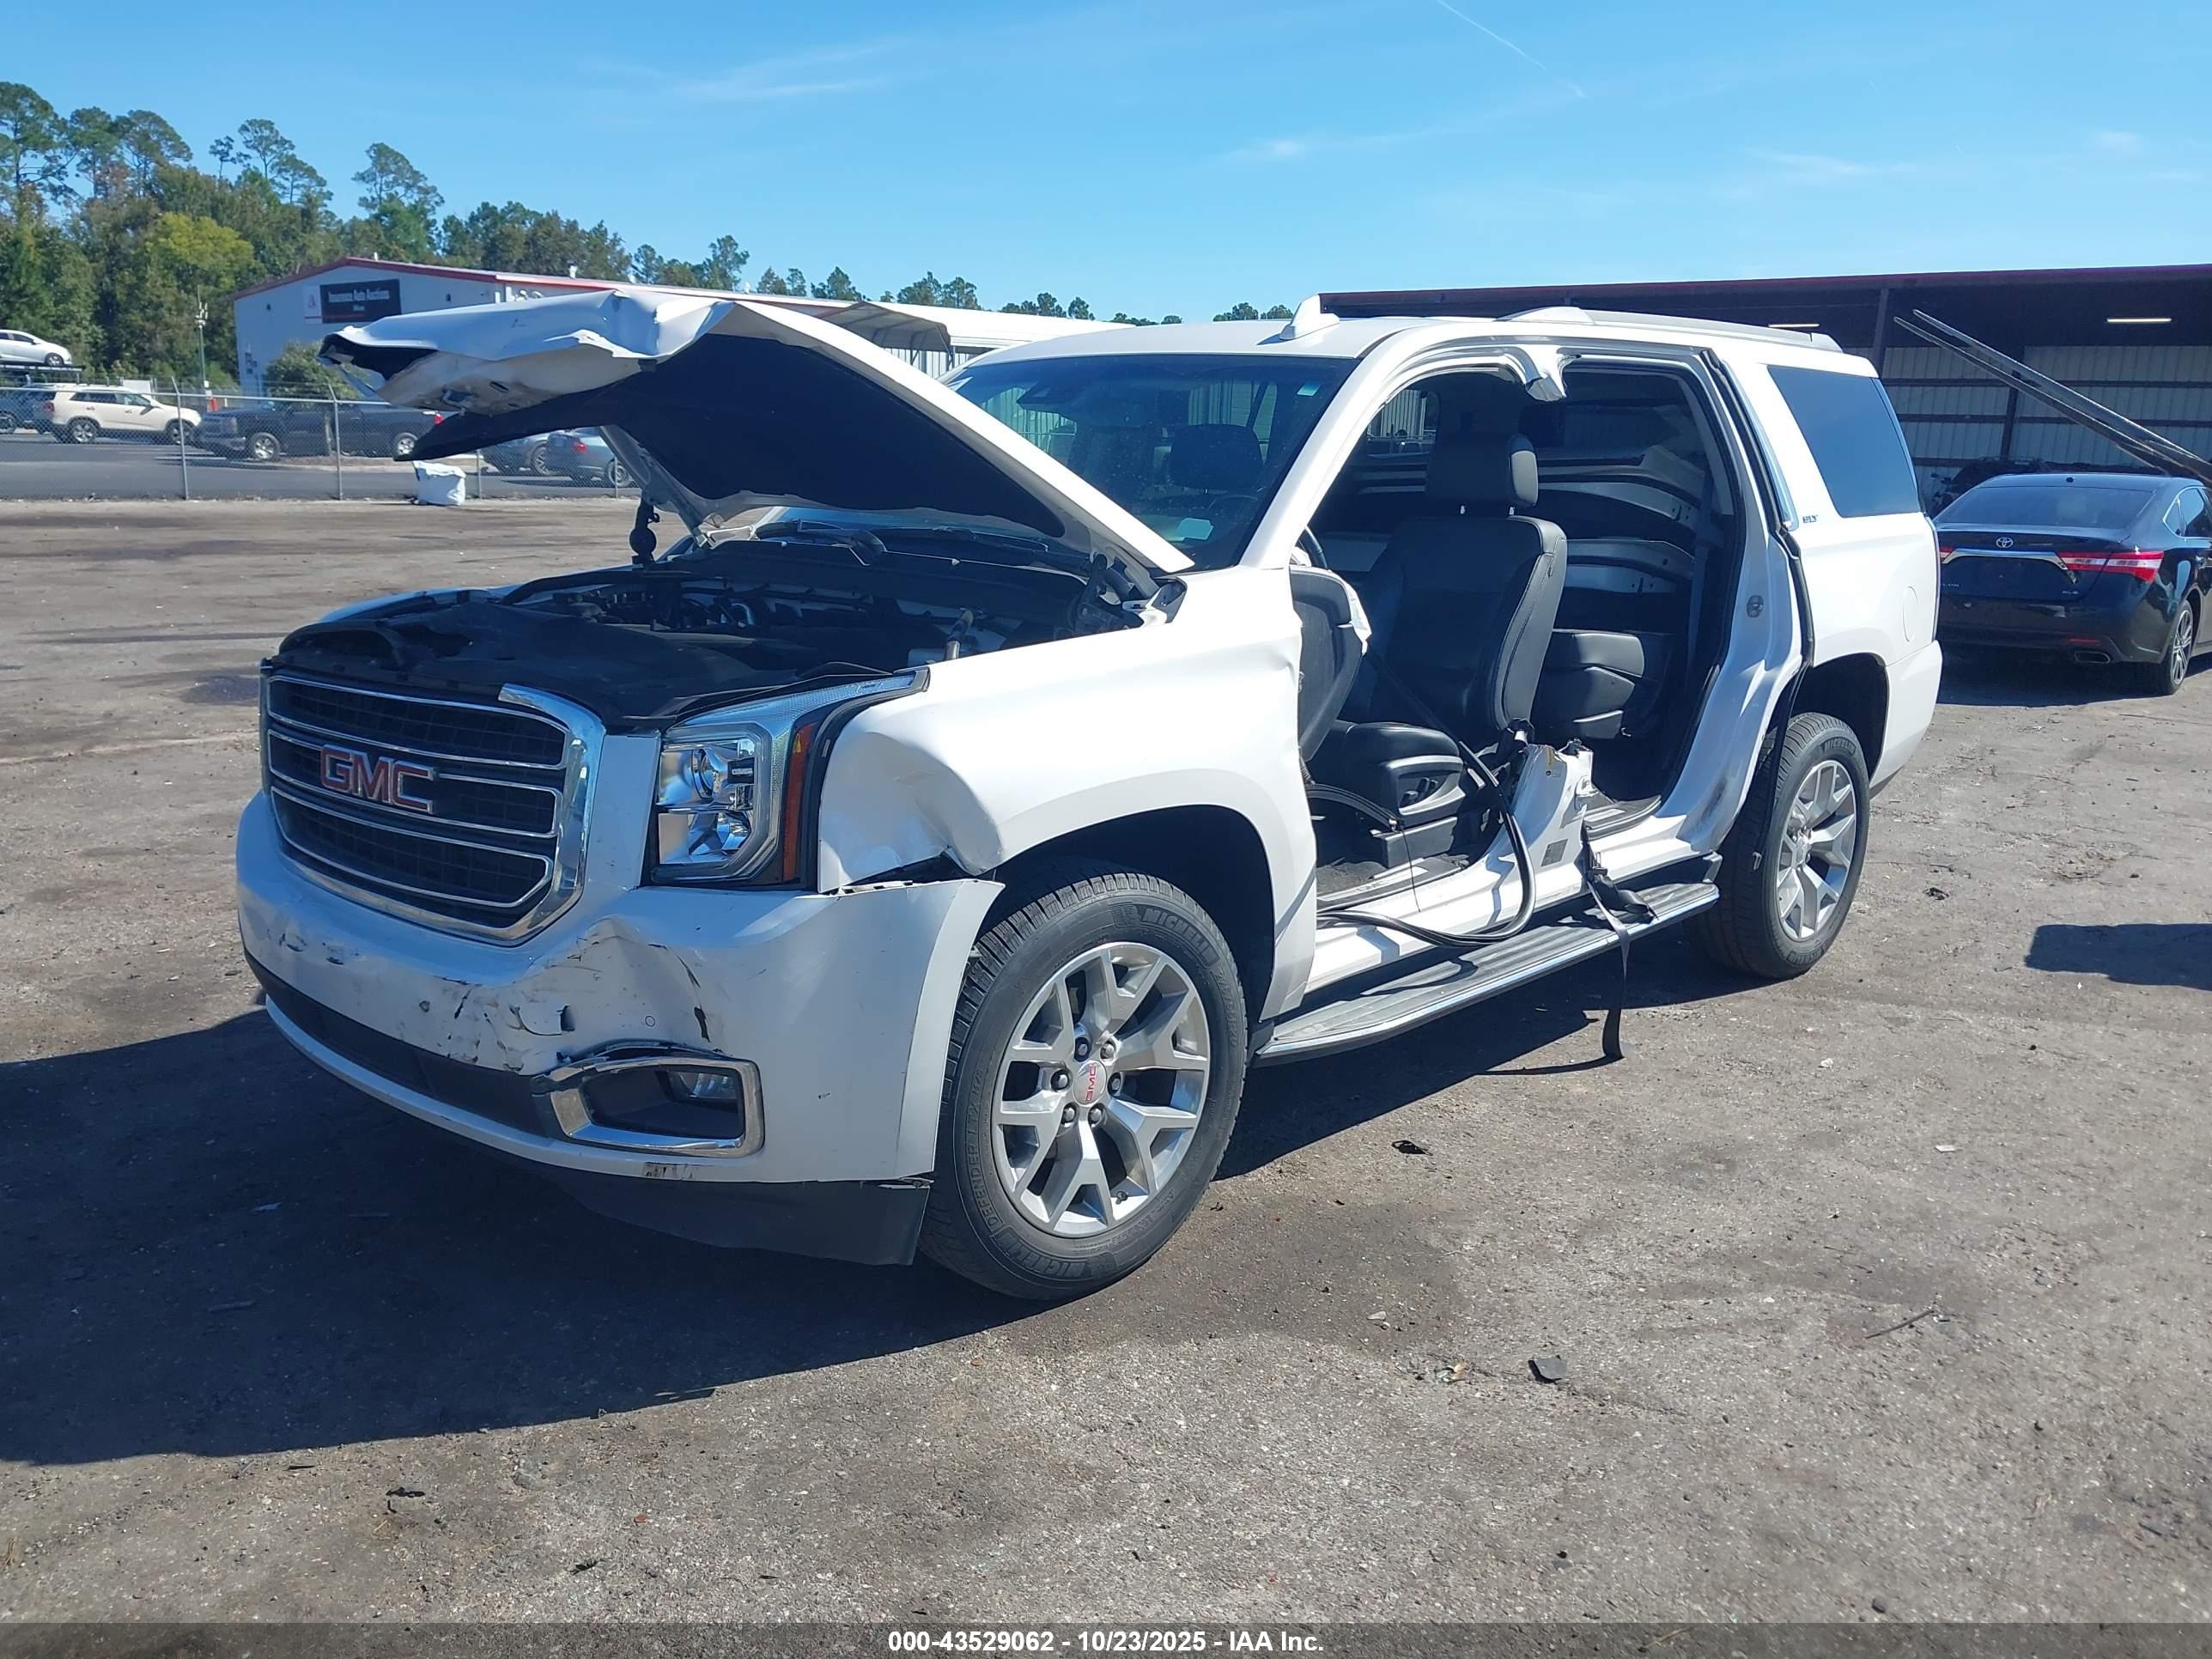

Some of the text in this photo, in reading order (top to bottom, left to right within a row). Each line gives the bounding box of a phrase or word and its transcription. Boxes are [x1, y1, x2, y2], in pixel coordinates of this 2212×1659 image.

[320, 744, 435, 814] GMC
[1142, 907, 1218, 965] MICHELIN
[1085, 1063, 1097, 1102] GMC
[967, 1145, 999, 1228] DEFENDER
